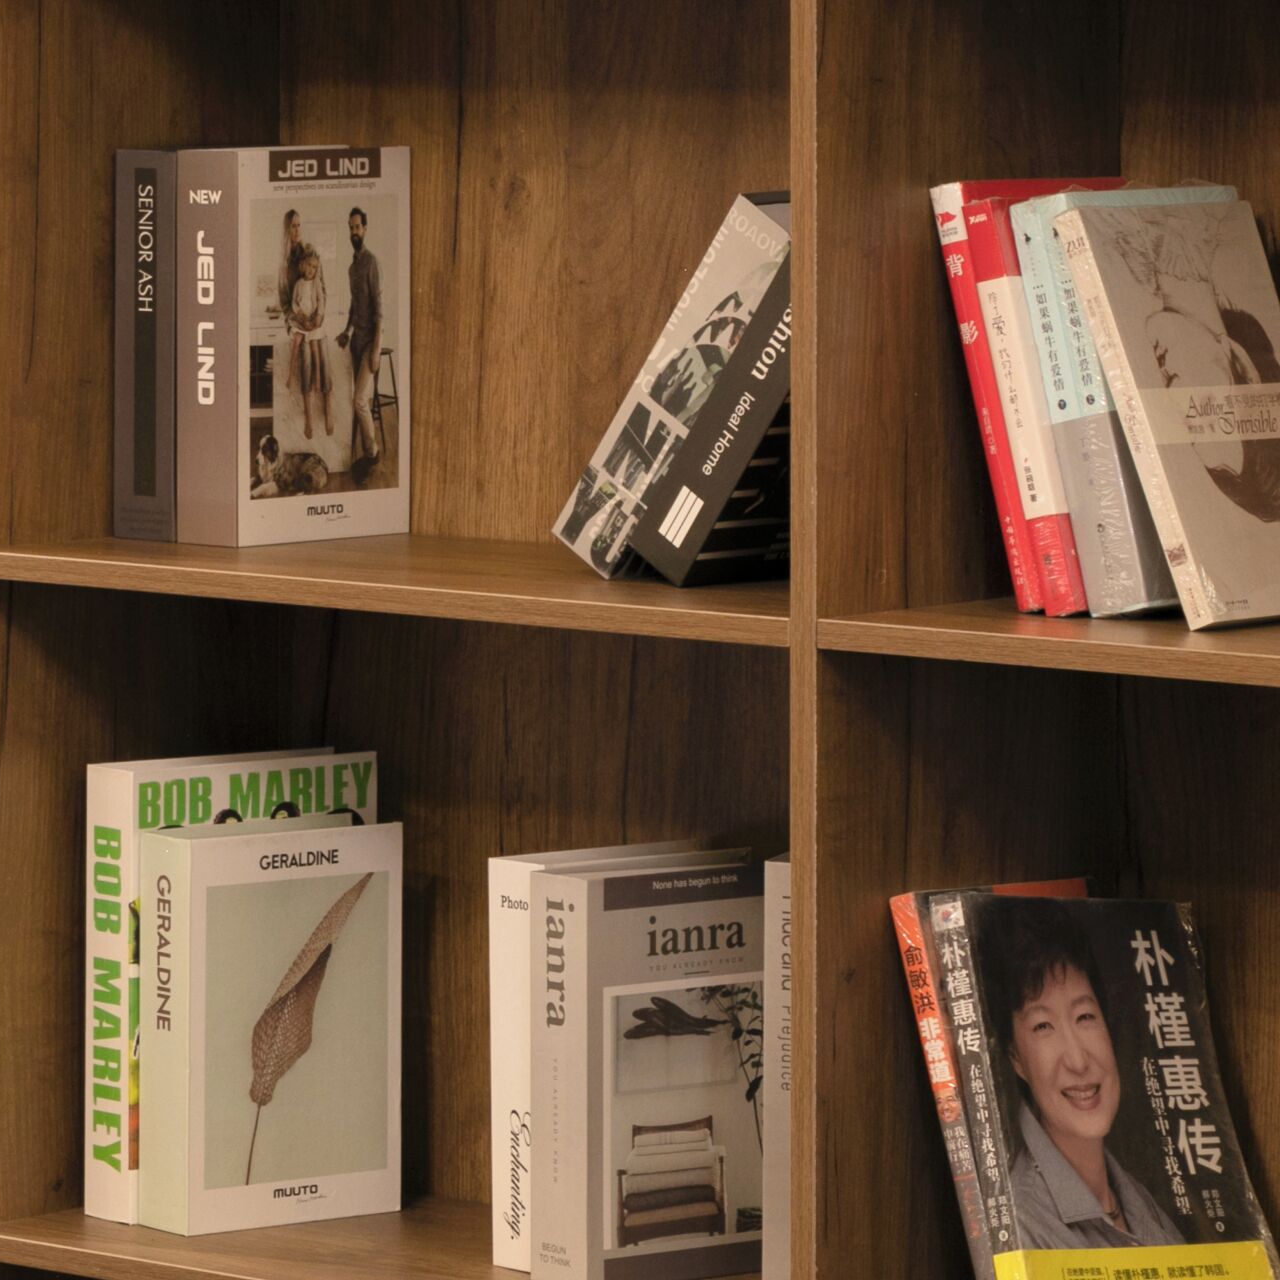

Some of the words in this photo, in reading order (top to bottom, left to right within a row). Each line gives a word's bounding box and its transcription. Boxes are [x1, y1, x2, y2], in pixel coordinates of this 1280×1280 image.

[189, 188, 222, 205] NEW
[277, 158, 319, 180] JED
[325, 156, 370, 177] LIND
[137, 184, 155, 263] SENIOR
[137, 268, 154, 313] ASH
[196, 230, 215, 305] JED
[946, 255, 979, 347] 背影
[196, 322, 216, 406] LIND
[1035, 293, 1066, 393] 如果蜗牛有爱情
[1063, 286, 1094, 388] 如果蜗牛有爱情
[732, 390, 755, 428] Ideal
[701, 424, 735, 477] Home
[306, 503, 344, 517] MUUTO
[139, 776, 213, 830] BOB
[228, 761, 373, 820] MARLEY
[92, 824, 123, 936] BOB
[259, 848, 340, 871] GERALDINE
[652, 878, 672, 891] None
[672, 877, 687, 890] has
[688, 877, 712, 891] begun
[712, 876, 720, 886] to
[720, 873, 739, 885] think
[500, 894, 529, 913] Photo
[647, 914, 747, 958] ianra
[156, 873, 172, 1033] GERALDINE
[545, 895, 575, 1029] ianra
[904, 945, 936, 1014] 俞敏洪
[940, 941, 982, 1056] 朴槿惠传
[92, 955, 123, 1175] MARLEY
[918, 1018, 953, 1084] 非常道
[1130, 929, 1224, 1177] 朴槿惠传
[273, 1183, 319, 1200] MUUTO
[541, 1241, 567, 1256] BEGUN
